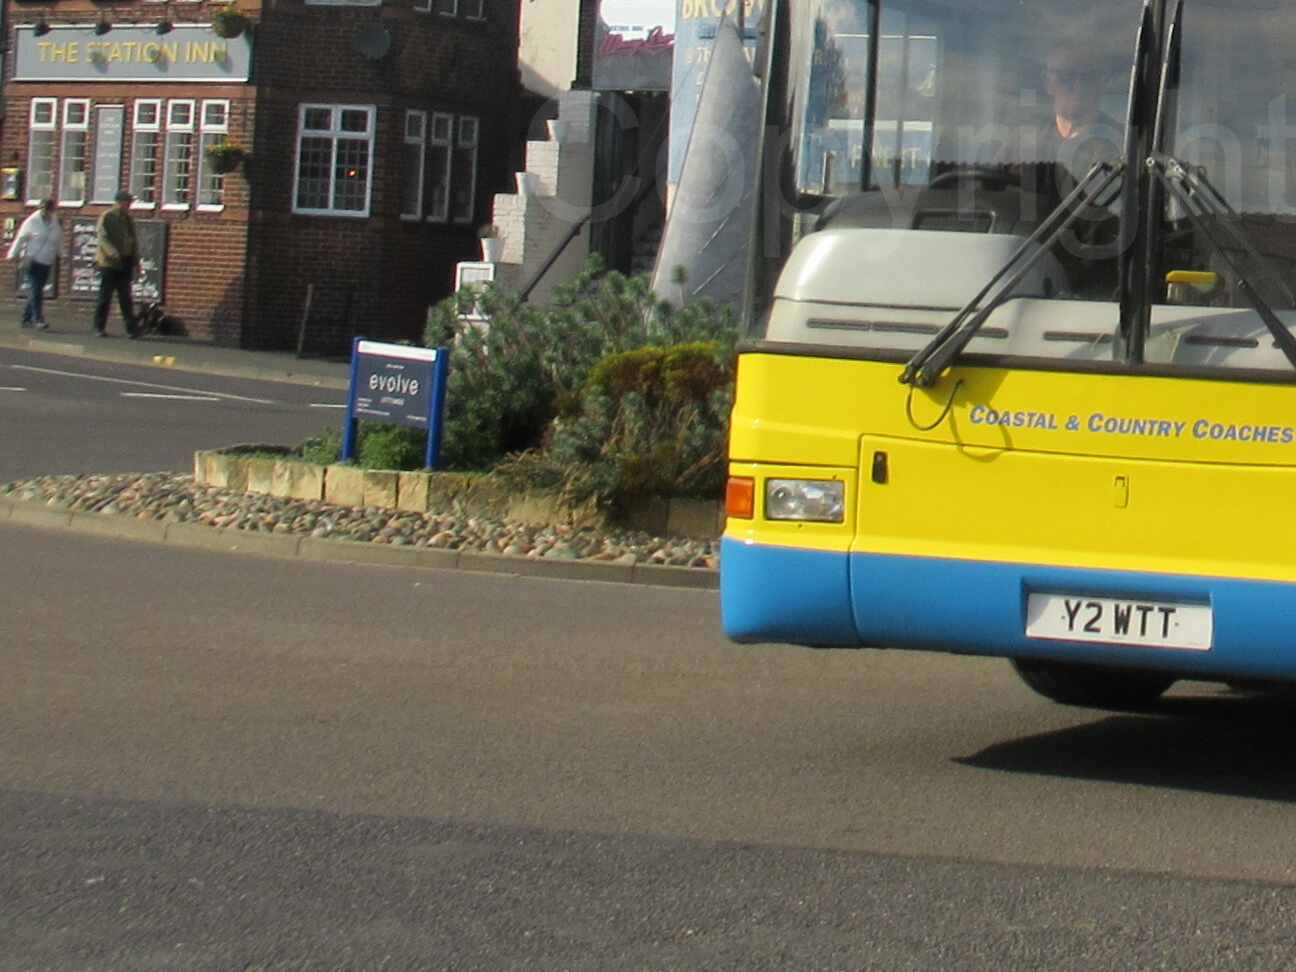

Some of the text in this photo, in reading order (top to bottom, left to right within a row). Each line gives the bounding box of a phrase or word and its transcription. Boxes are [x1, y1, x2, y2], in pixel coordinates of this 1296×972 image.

[37, 41, 228, 64] THE STATION INN
[368, 372, 419, 396] evolve
[1065, 414, 1081, 431] &
[1063, 599, 1177, 639] Y2 WTT
